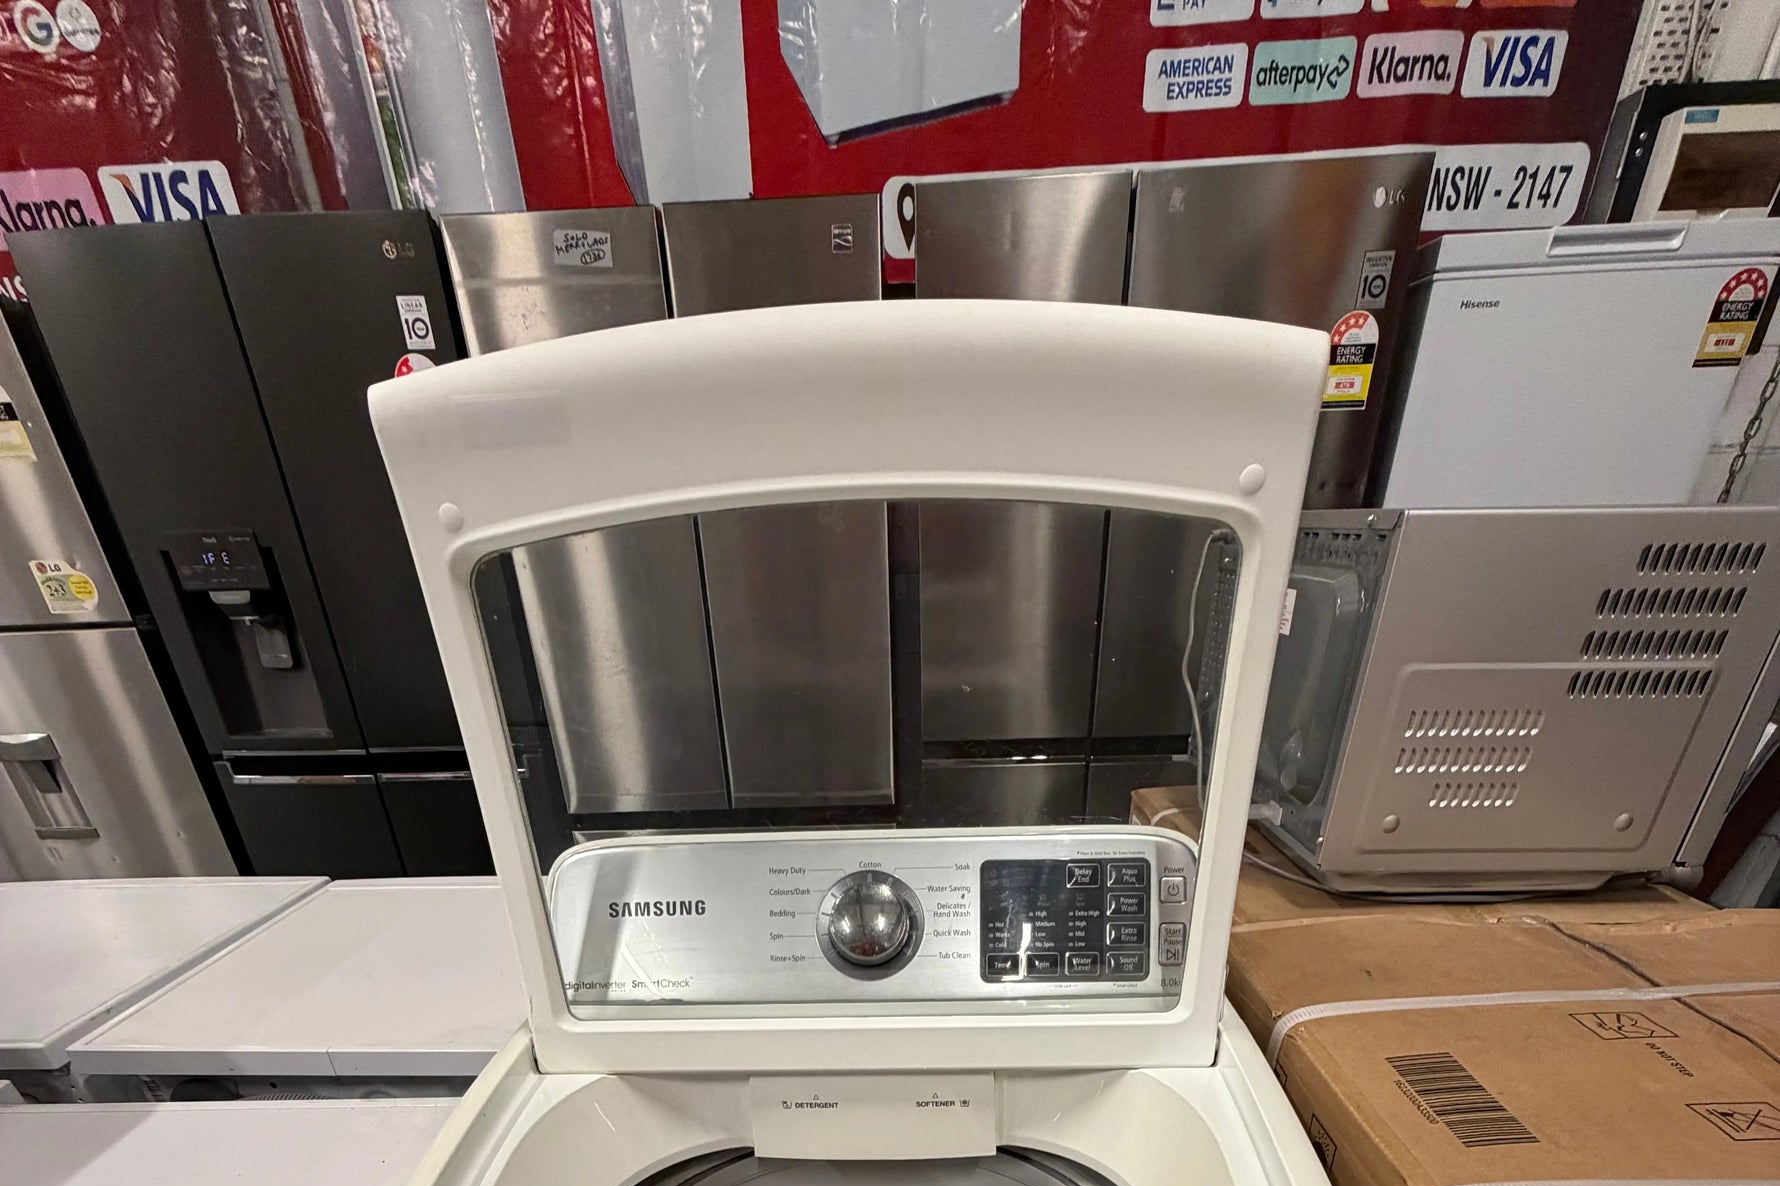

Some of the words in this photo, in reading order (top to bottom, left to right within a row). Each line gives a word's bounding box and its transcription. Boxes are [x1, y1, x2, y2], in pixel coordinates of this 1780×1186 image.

[1368, 46, 1451, 85] Klarna.
[1482, 36, 1556, 88] VISA
[1158, 55, 1235, 80] AMERICAN
[1256, 60, 1329, 92] afterpay
[1166, 78, 1233, 101] EXPRESS
[1427, 166, 1492, 211] NSW
[1507, 165, 1574, 209] 2147
[110, 169, 226, 224] VISA
[1361, 274, 1387, 299] 10
[1460, 300, 1500, 310] Hisense
[404, 317, 430, 340] 10
[1337, 346, 1366, 355] ENERGY
[1335, 355, 1363, 364] RATING
[859, 861, 882, 869] Cotton
[769, 867, 789, 876] Heavy
[790, 867, 806, 875] Duty
[1074, 868, 1093, 876] Delay
[769, 888, 811, 896] Colours/Dark
[949, 884, 971, 894] Saving
[608, 900, 706, 918] SAMSUNG
[937, 902, 967, 910] Delicates
[769, 910, 796, 918] Bedding
[933, 929, 951, 937] Quick
[1164, 927, 1182, 935] Start
[769, 932, 784, 941] Spin
[770, 954, 806, 964] Rinse+Spin
[631, 978, 690, 989] SmrtCheck
